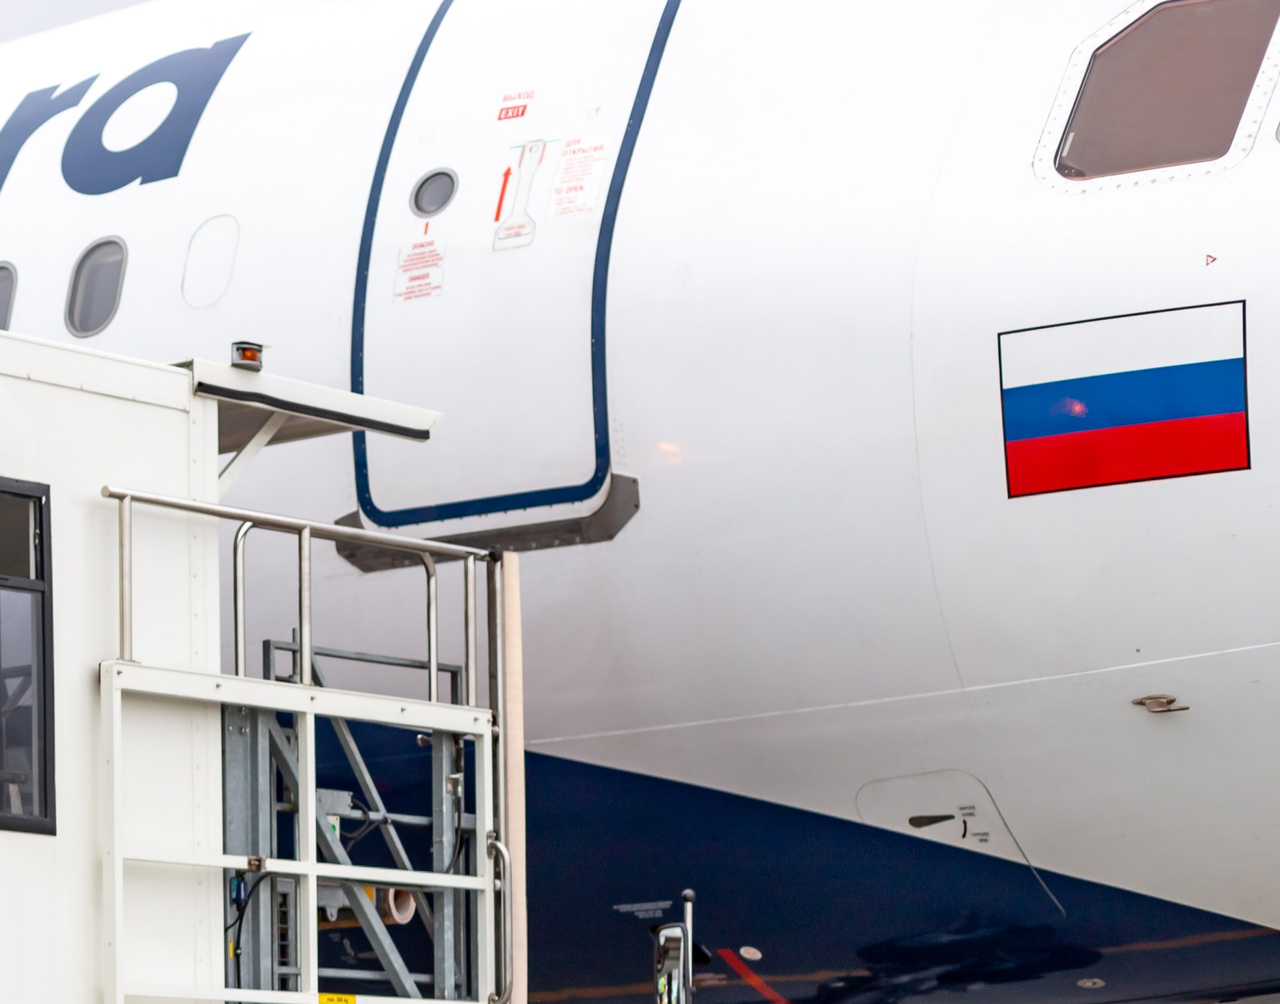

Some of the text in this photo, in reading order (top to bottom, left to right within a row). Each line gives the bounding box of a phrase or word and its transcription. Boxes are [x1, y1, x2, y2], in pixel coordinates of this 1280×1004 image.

[500, 106, 527, 120] EXIT
[554, 184, 584, 196] TO OPEN
